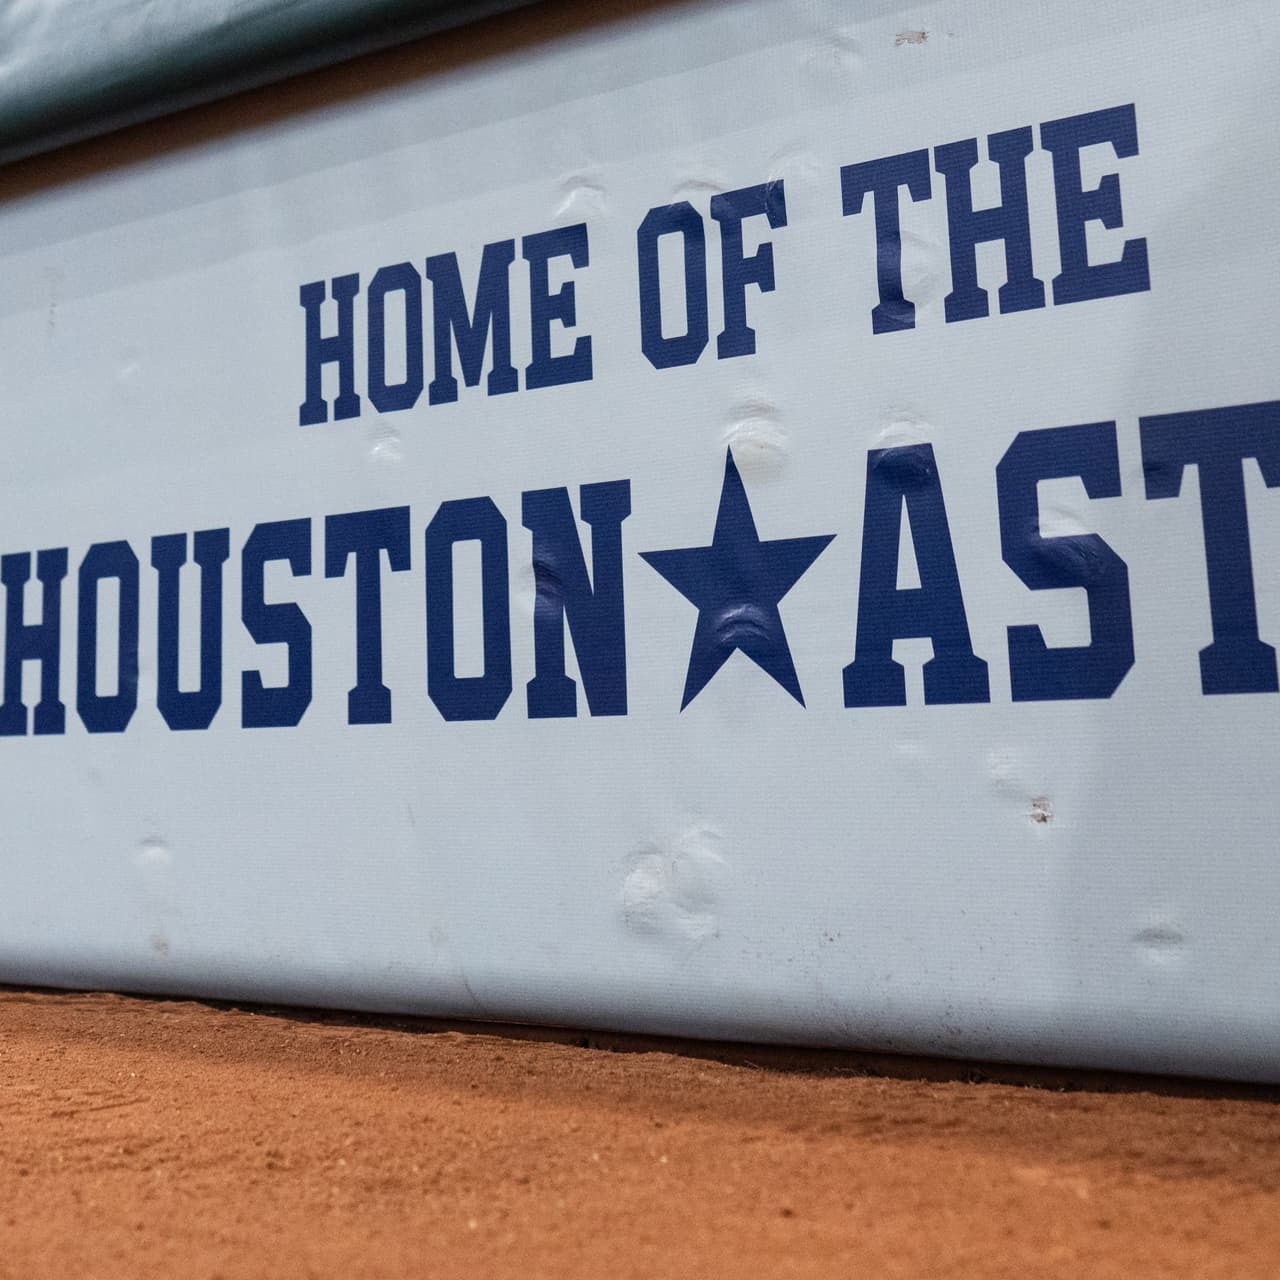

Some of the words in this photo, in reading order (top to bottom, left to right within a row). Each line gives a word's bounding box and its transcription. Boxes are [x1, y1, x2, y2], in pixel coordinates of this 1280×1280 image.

[300, 223, 593, 426] HOME
[637, 179, 787, 369] OF
[840, 103, 1150, 334] THE
